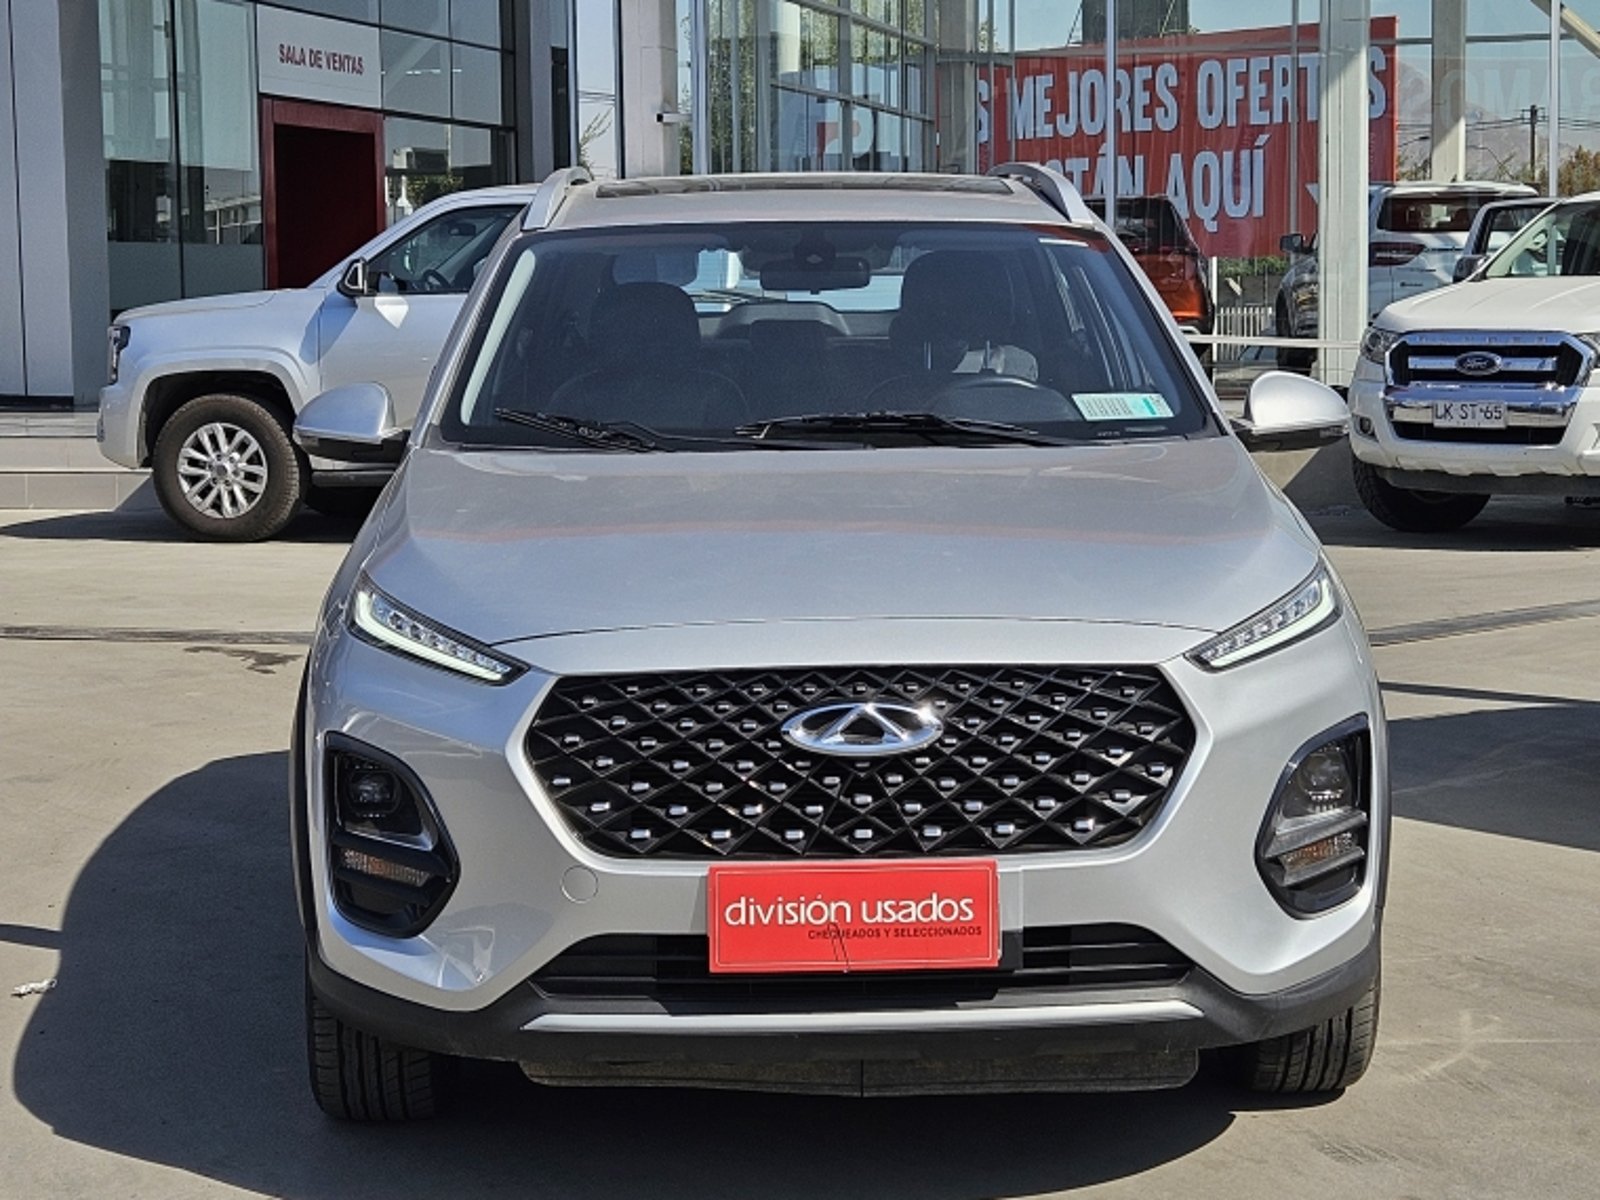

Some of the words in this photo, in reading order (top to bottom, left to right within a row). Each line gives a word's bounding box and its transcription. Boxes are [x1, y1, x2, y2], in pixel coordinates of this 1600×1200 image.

[279, 43, 306, 66] SALA
[309, 48, 322, 69] DE
[324, 50, 363, 76] VENTAS
[1006, 62, 1178, 140] MEJORES
[1197, 46, 1387, 130] OFERTS
[1166, 134, 1270, 232] AQUÍ
[724, 894, 852, 926] división
[861, 892, 974, 924] usados
[808, 927, 881, 940] CHEQUEADOS
[884, 927, 891, 938] Y
[893, 925, 982, 938] SELECCIONADOS
